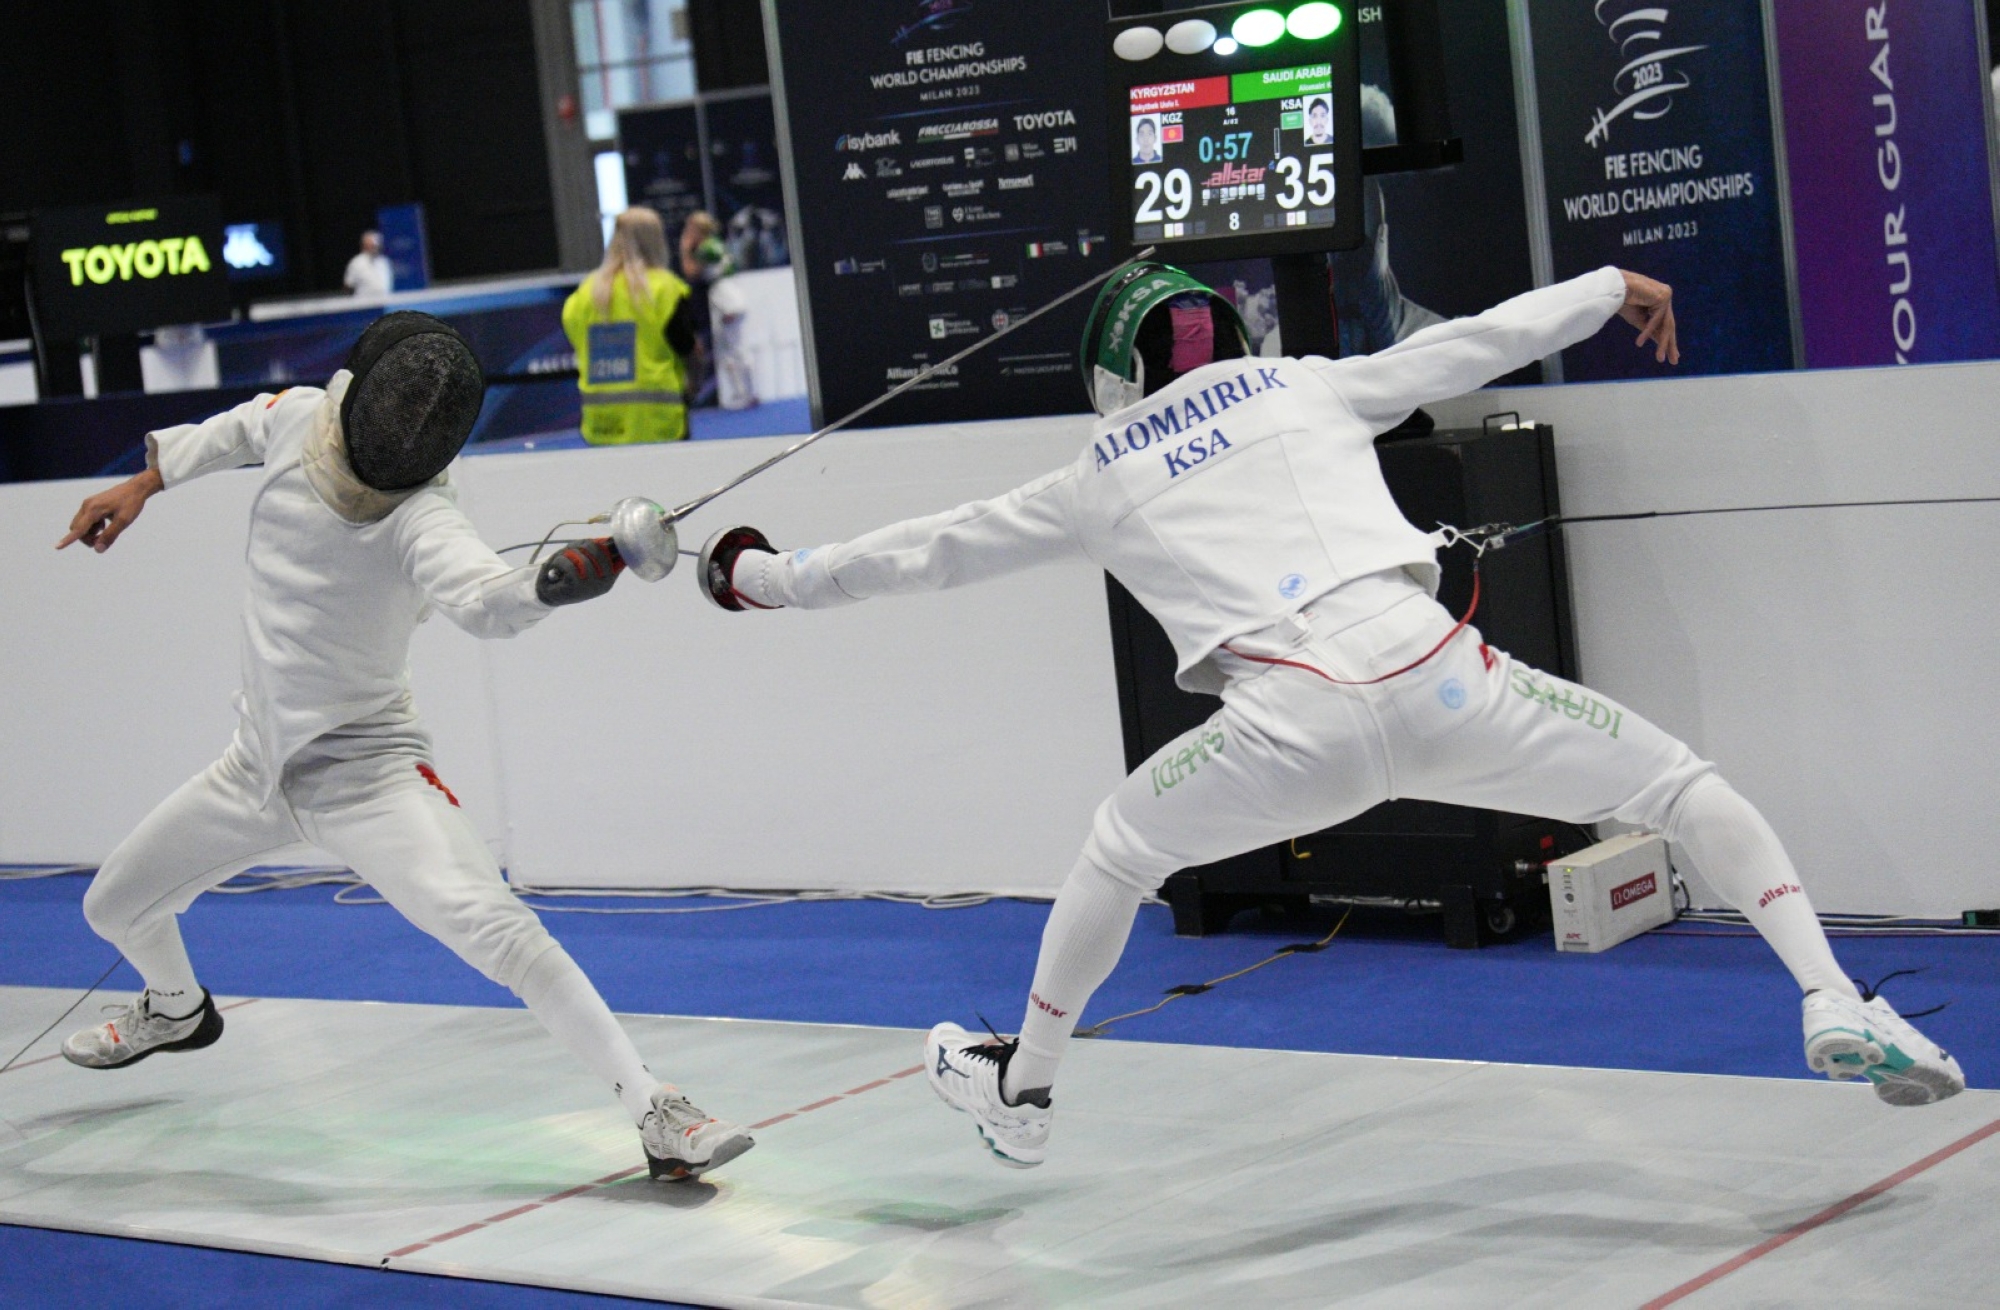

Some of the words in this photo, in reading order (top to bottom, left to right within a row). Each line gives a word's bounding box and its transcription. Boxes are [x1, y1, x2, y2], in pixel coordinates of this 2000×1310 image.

[905, 50, 924, 65] FIE
[926, 42, 985, 63] FENCING
[870, 69, 918, 89] WORLD
[919, 56, 1027, 84] CHAMPIONSHIPS
[1262, 72, 1294, 84] SAUDI
[1295, 65, 1332, 80] ARABIA
[1632, 61, 1663, 90] 2023
[920, 88, 953, 101] MILAN
[956, 84, 980, 98] 2023
[1130, 82, 1195, 100] KYRGYZSTAN
[1865, 0, 1902, 191] GUAR
[1162, 111, 1183, 125] KGZ
[1280, 98, 1303, 112] KSA
[918, 118, 999, 137] FRECCIAROSSA
[1014, 109, 1076, 131] TOYOTA
[847, 129, 901, 153] isybank
[1199, 131, 1254, 164] 0:57
[1210, 162, 1267, 187] allstar
[1604, 154, 1628, 180] FIE
[1629, 144, 1703, 177] FENCING
[1275, 152, 1336, 210] 35
[1134, 167, 1193, 224] 29
[1563, 191, 1621, 222] WORLD
[1621, 172, 1755, 214] CHAMPIONSHIPS
[1229, 212, 1240, 231] 8
[1622, 225, 1664, 247] MILAN
[1667, 220, 1699, 240] 2023
[61, 235, 212, 287] TOYOTA
[1093, 367, 1289, 474] ALOMAIRI.K
[1163, 427, 1234, 479] KSA
[1510, 668, 1624, 740] SAUDI
[1622, 880, 1654, 901] OMEGA
